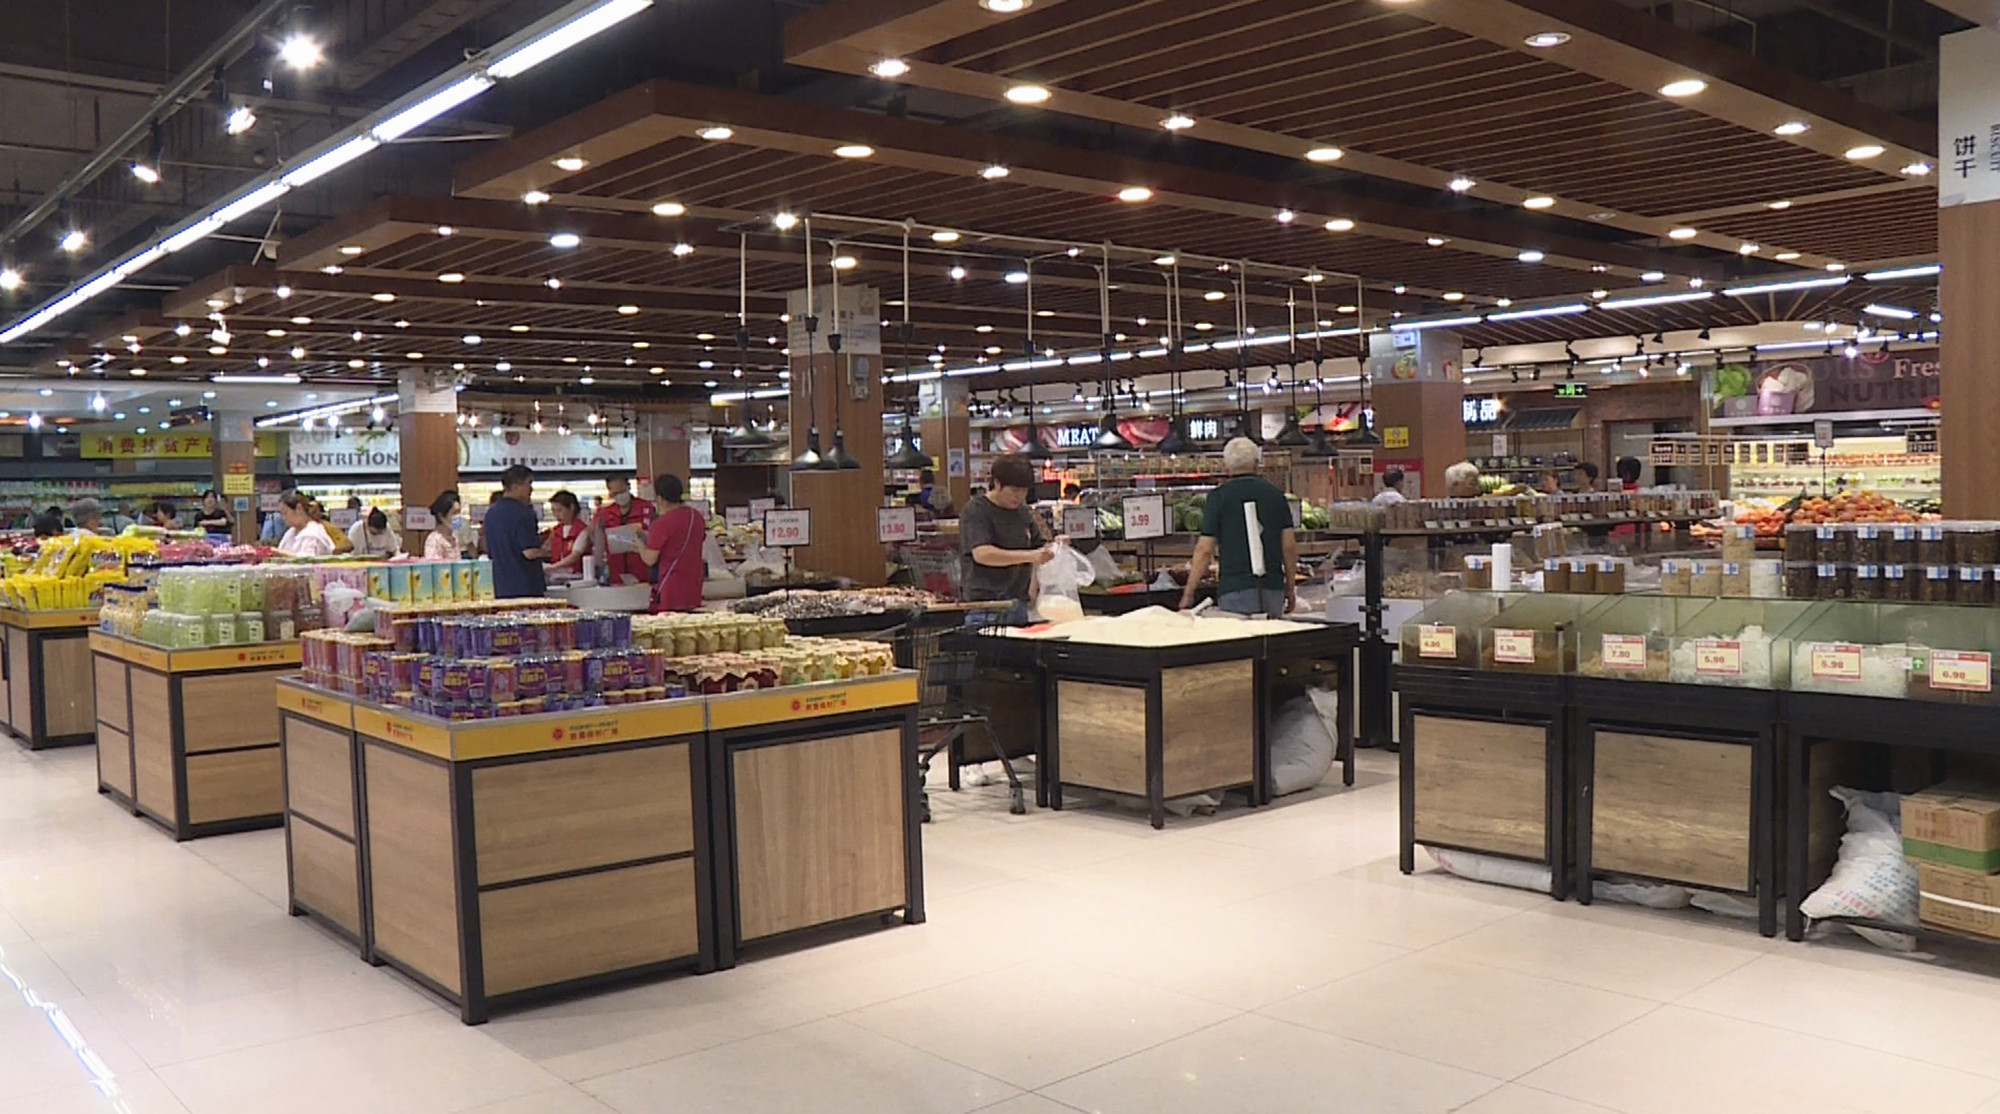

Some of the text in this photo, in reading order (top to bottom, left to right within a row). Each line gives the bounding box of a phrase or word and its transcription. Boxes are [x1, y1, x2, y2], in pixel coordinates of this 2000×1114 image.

[1953, 135, 1976, 178] 饼干
[1056, 428, 1098, 446] MEAT
[1190, 419, 1218, 440] 鲜肉
[296, 451, 399, 466] NUTRITION
